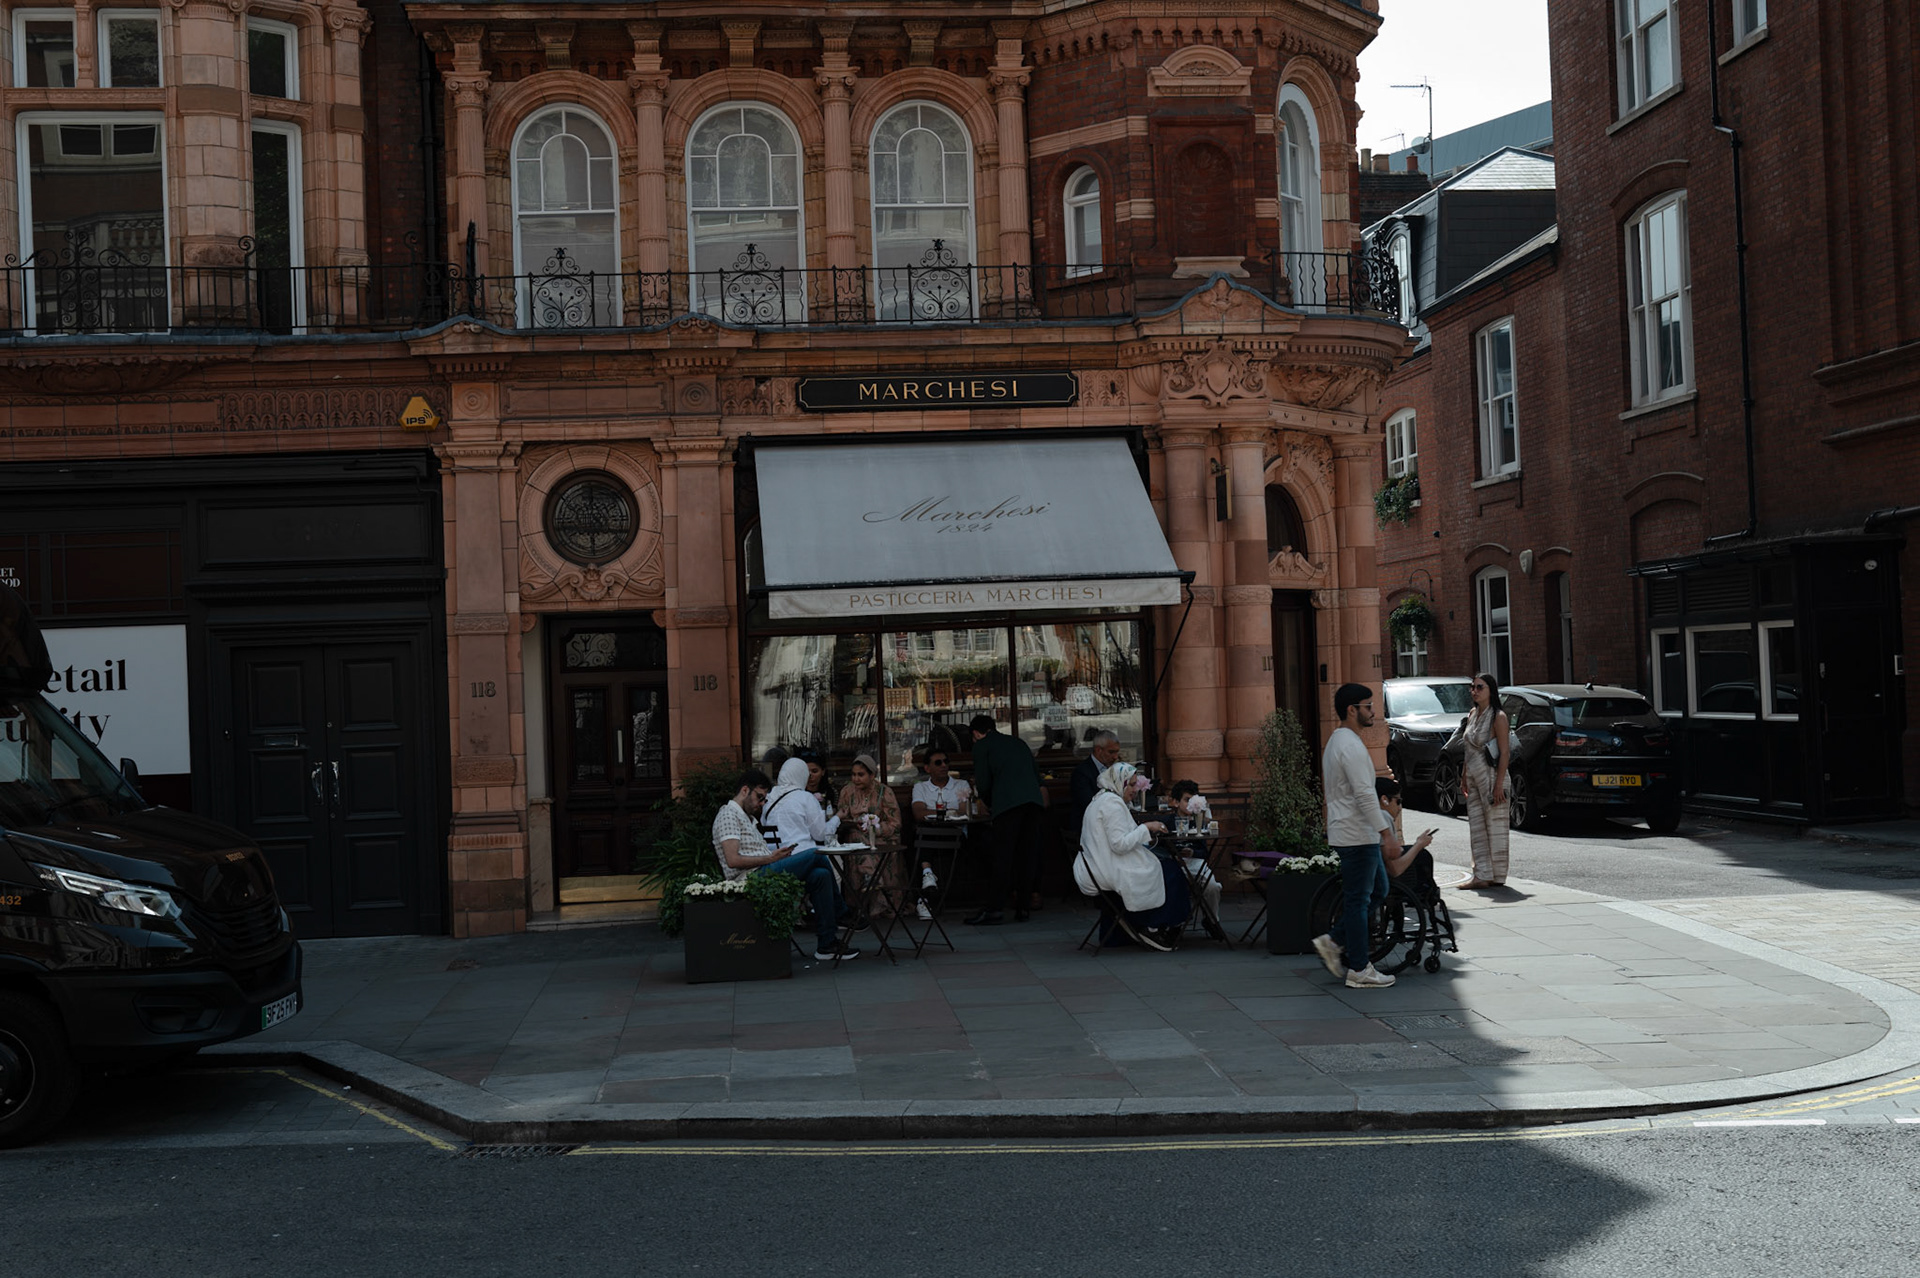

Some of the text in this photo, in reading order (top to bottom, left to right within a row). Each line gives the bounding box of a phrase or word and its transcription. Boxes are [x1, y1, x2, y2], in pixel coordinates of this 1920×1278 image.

[858, 380, 1018, 400] MARCHESI
[406, 416, 426, 424] IPS
[862, 494, 1051, 524] Marchesi
[937, 522, 995, 534] 1824
[0, 567, 15, 577] ET
[850, 587, 1103, 608] PASTICCERIA MARCHESI
[471, 681, 496, 698] 118
[693, 675, 718, 691] 118
[1597, 776, 1618, 785] LJ21
[0, 895, 22, 906] 432
